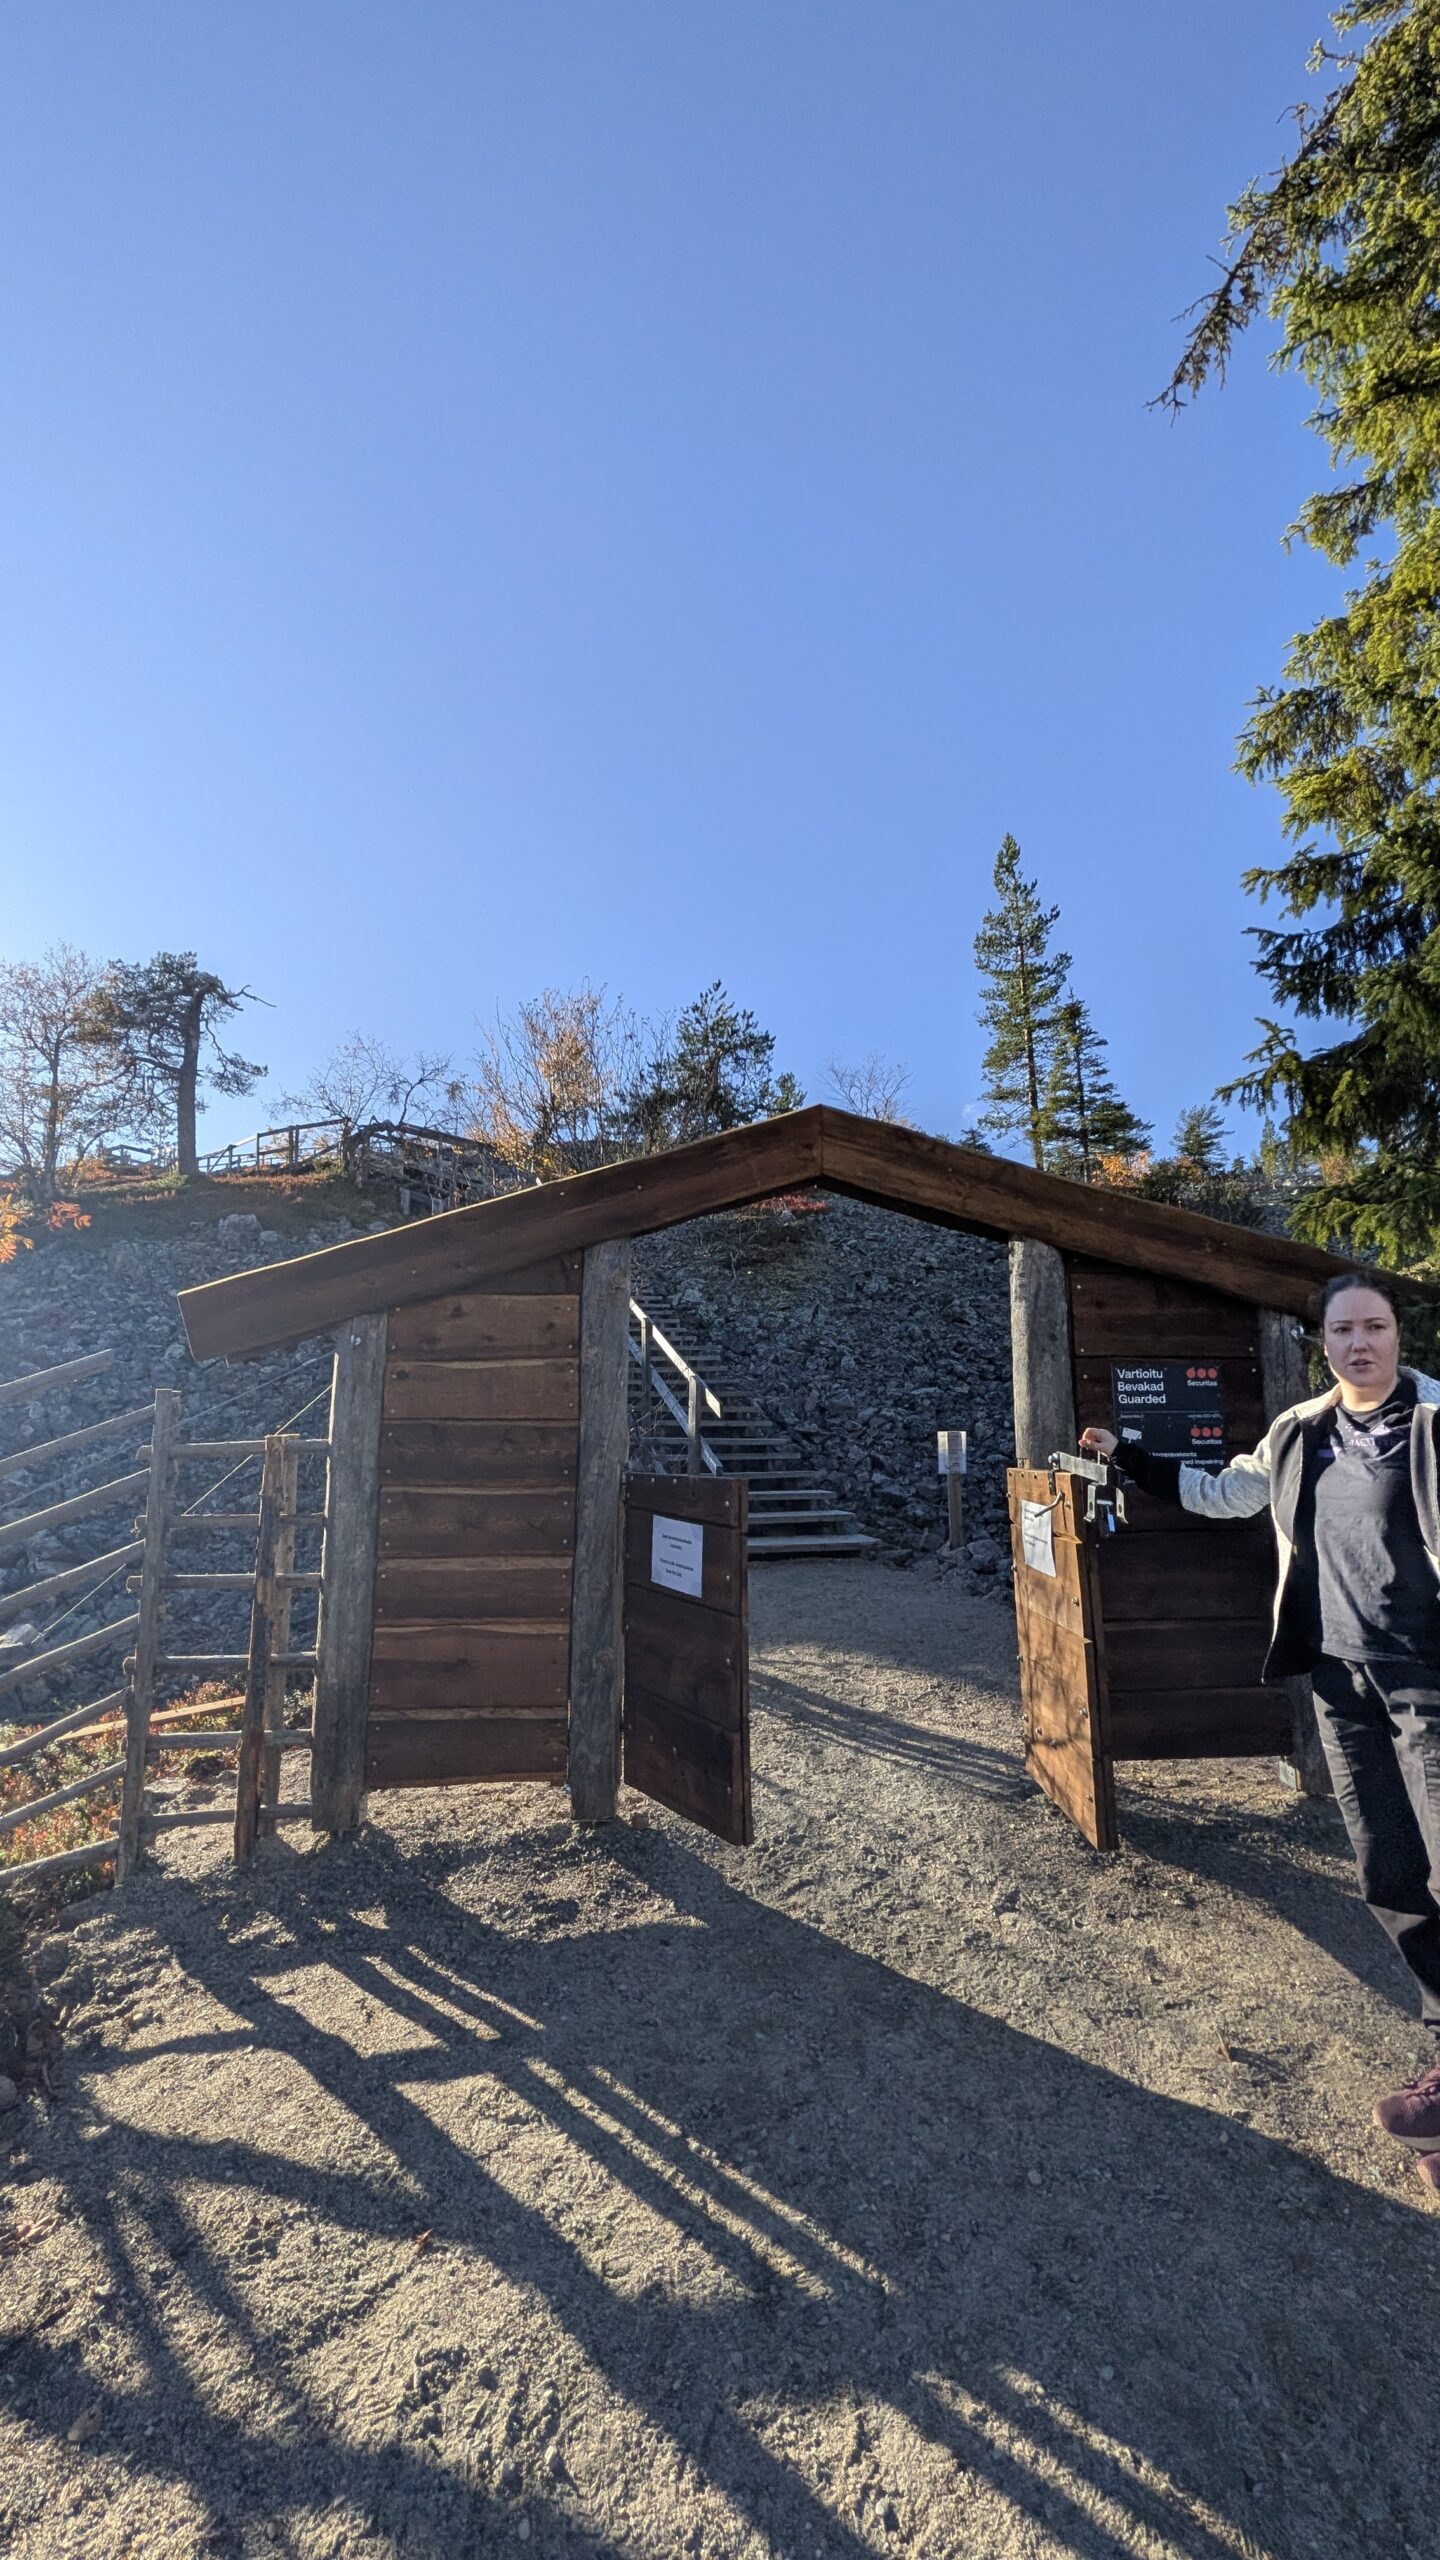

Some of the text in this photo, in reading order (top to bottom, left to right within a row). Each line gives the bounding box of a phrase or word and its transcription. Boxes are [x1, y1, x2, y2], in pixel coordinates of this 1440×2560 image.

[1117, 1368, 1163, 1379] Vartioitu
[1117, 1381, 1165, 1391] Bevakad
[1118, 1394, 1166, 1404] Guarded
